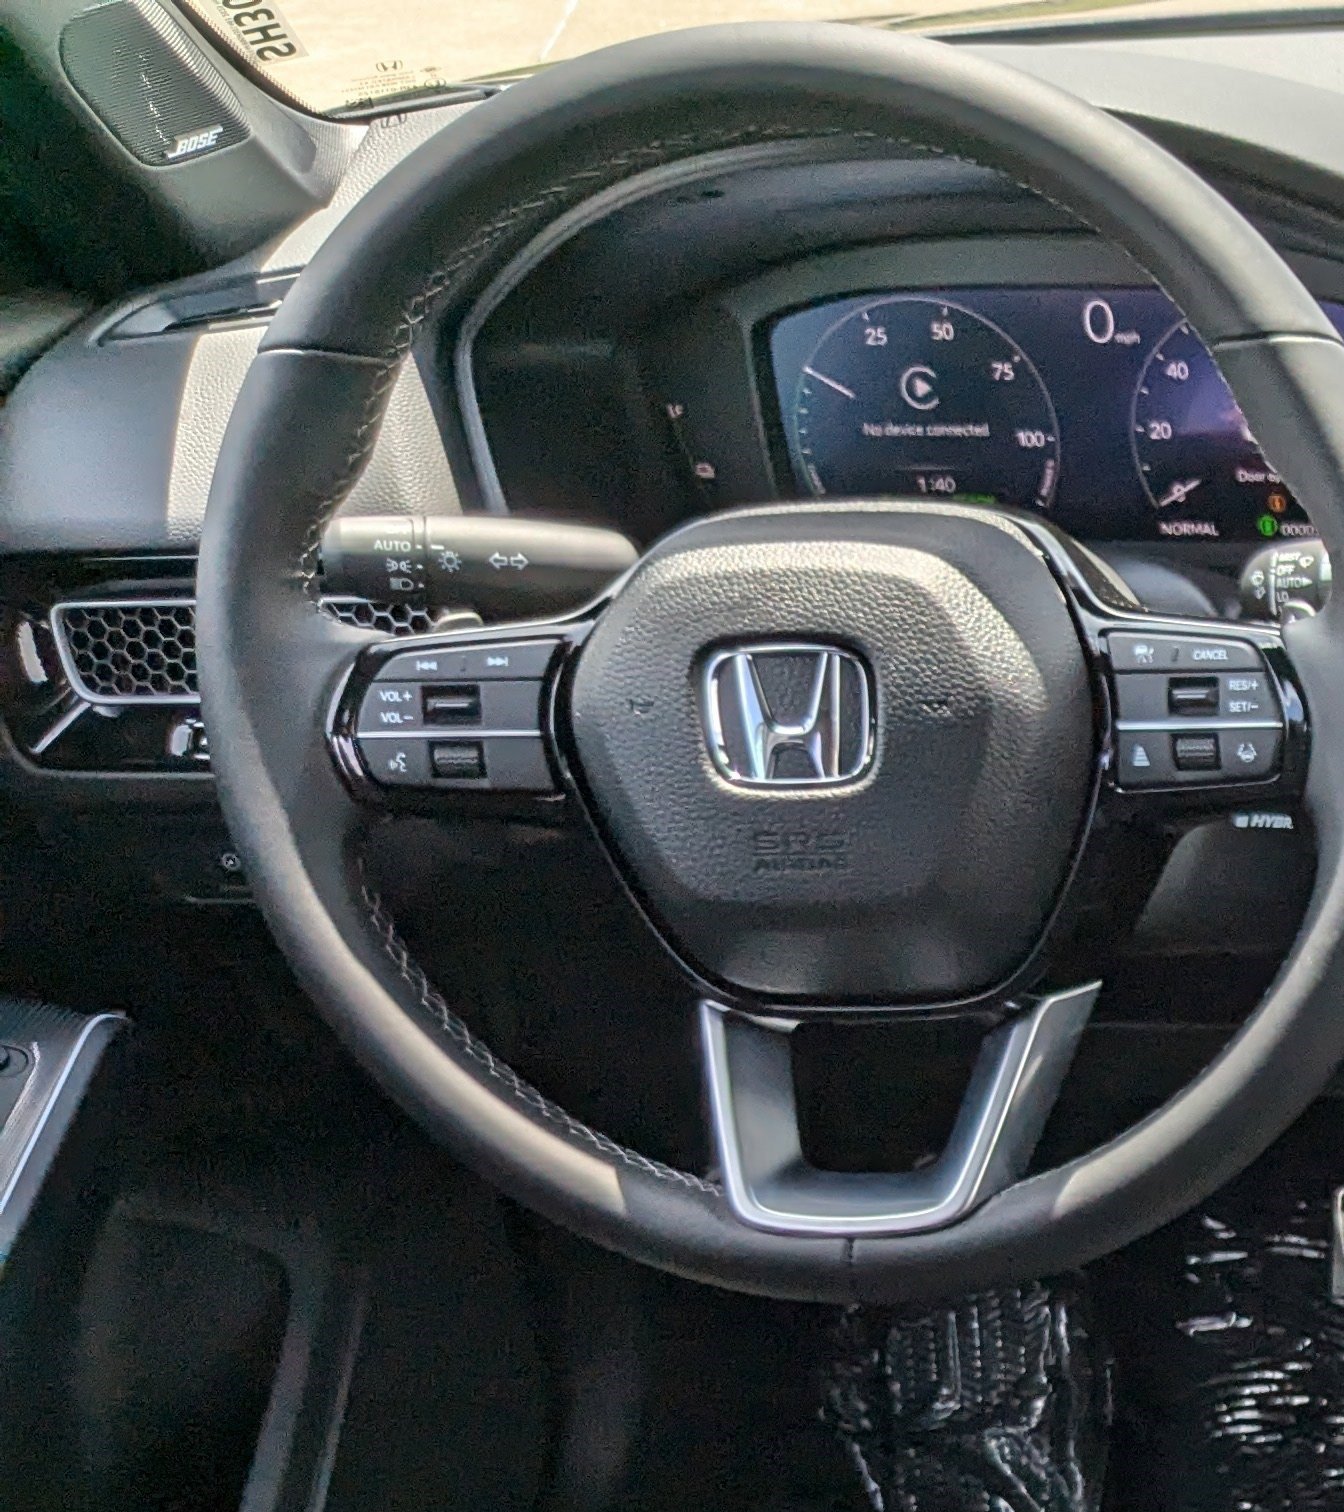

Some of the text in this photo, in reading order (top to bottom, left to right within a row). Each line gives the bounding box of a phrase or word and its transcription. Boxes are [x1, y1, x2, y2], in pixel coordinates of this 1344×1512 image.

[168, 126, 223, 158] BOSE
[1083, 300, 1114, 343] 0
[866, 328, 888, 346] 25
[931, 322, 954, 341] 50
[991, 361, 1015, 381] 75
[1166, 362, 1189, 381] 40
[1016, 431, 1045, 447] 100
[1150, 423, 1172, 440] 20
[917, 476, 956, 493] 1:40
[1159, 522, 1219, 537] NORMAL
[374, 540, 412, 551] AUTO
[1277, 564, 1295, 576] OFF
[1276, 577, 1301, 588] AUTO
[1192, 649, 1228, 661] CANCEL
